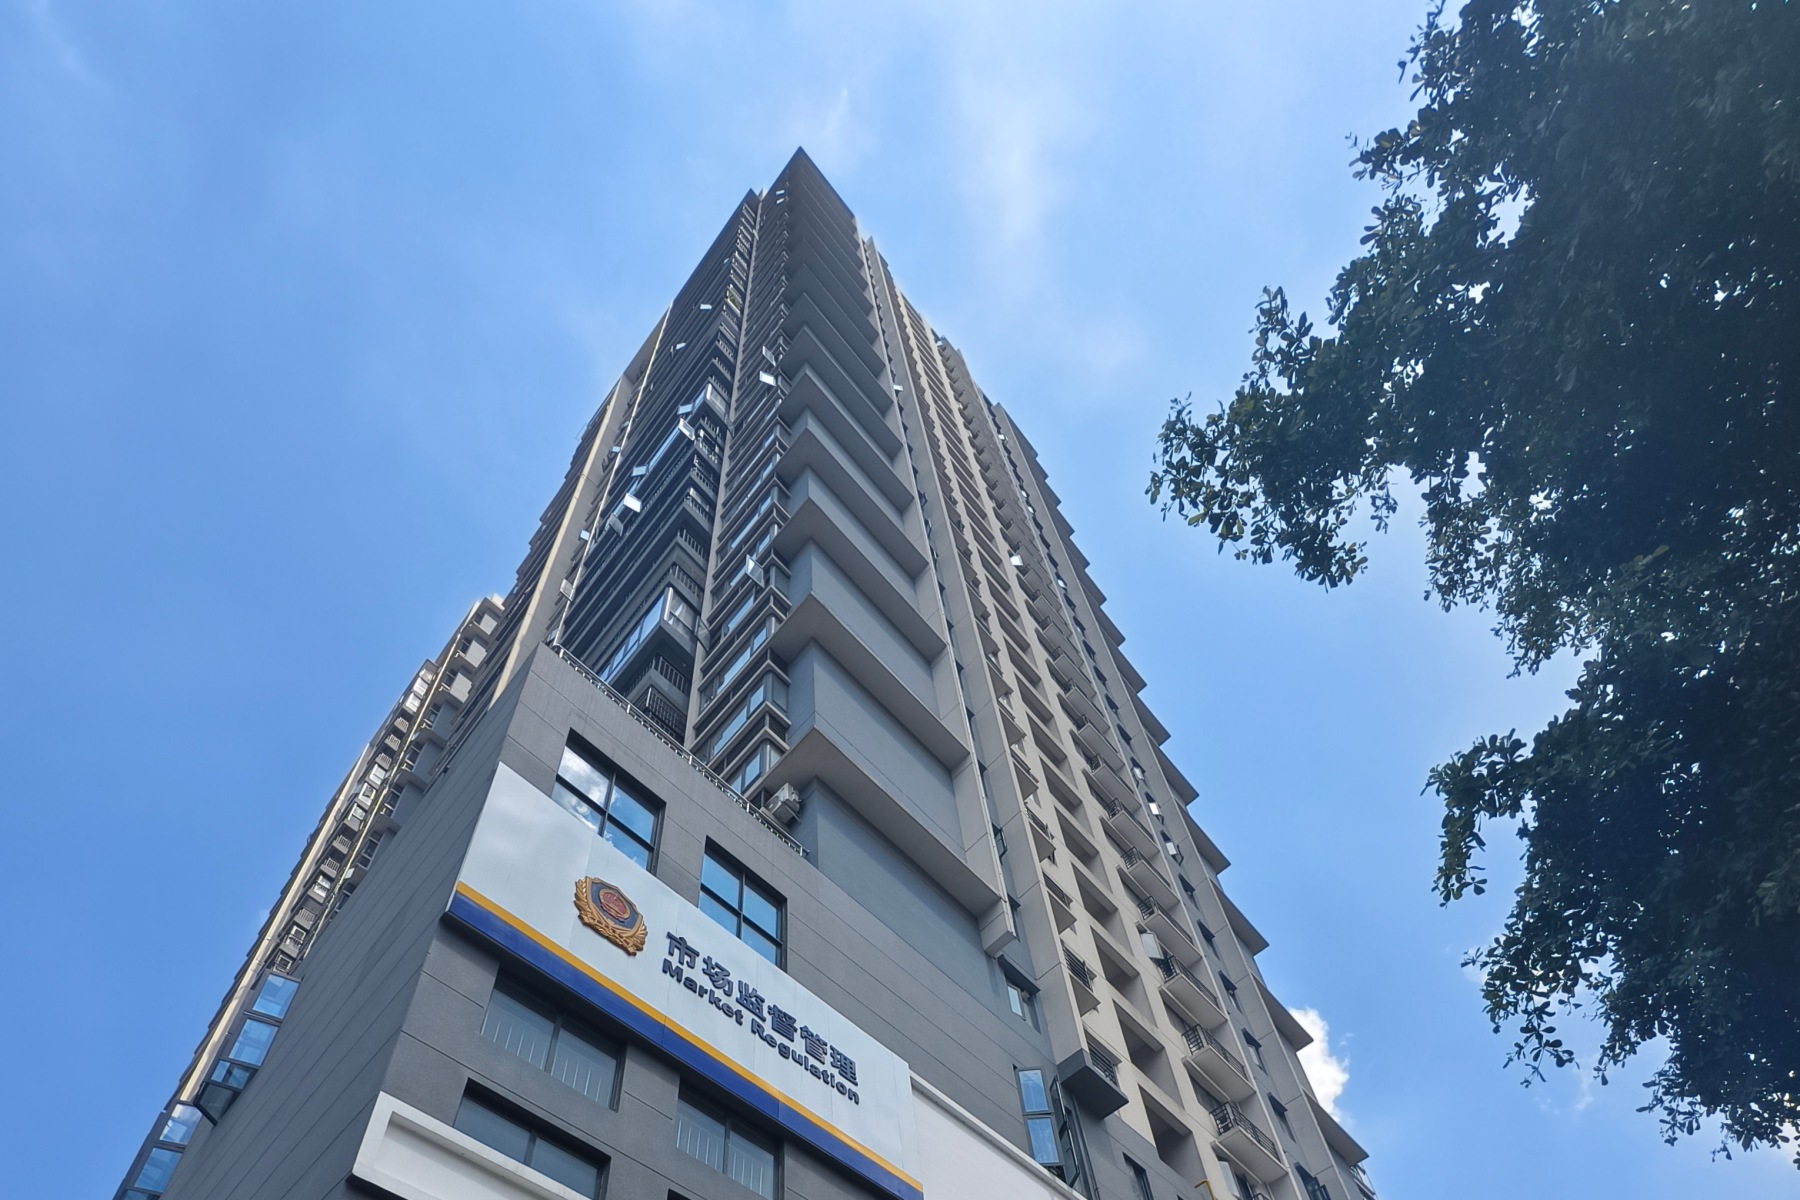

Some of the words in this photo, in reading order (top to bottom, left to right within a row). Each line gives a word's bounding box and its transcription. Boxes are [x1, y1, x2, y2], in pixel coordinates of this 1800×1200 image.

[662, 958, 743, 1026] Market
[751, 1017, 860, 1104] Regulation
[666, 931, 858, 1086] 市场监督管理
